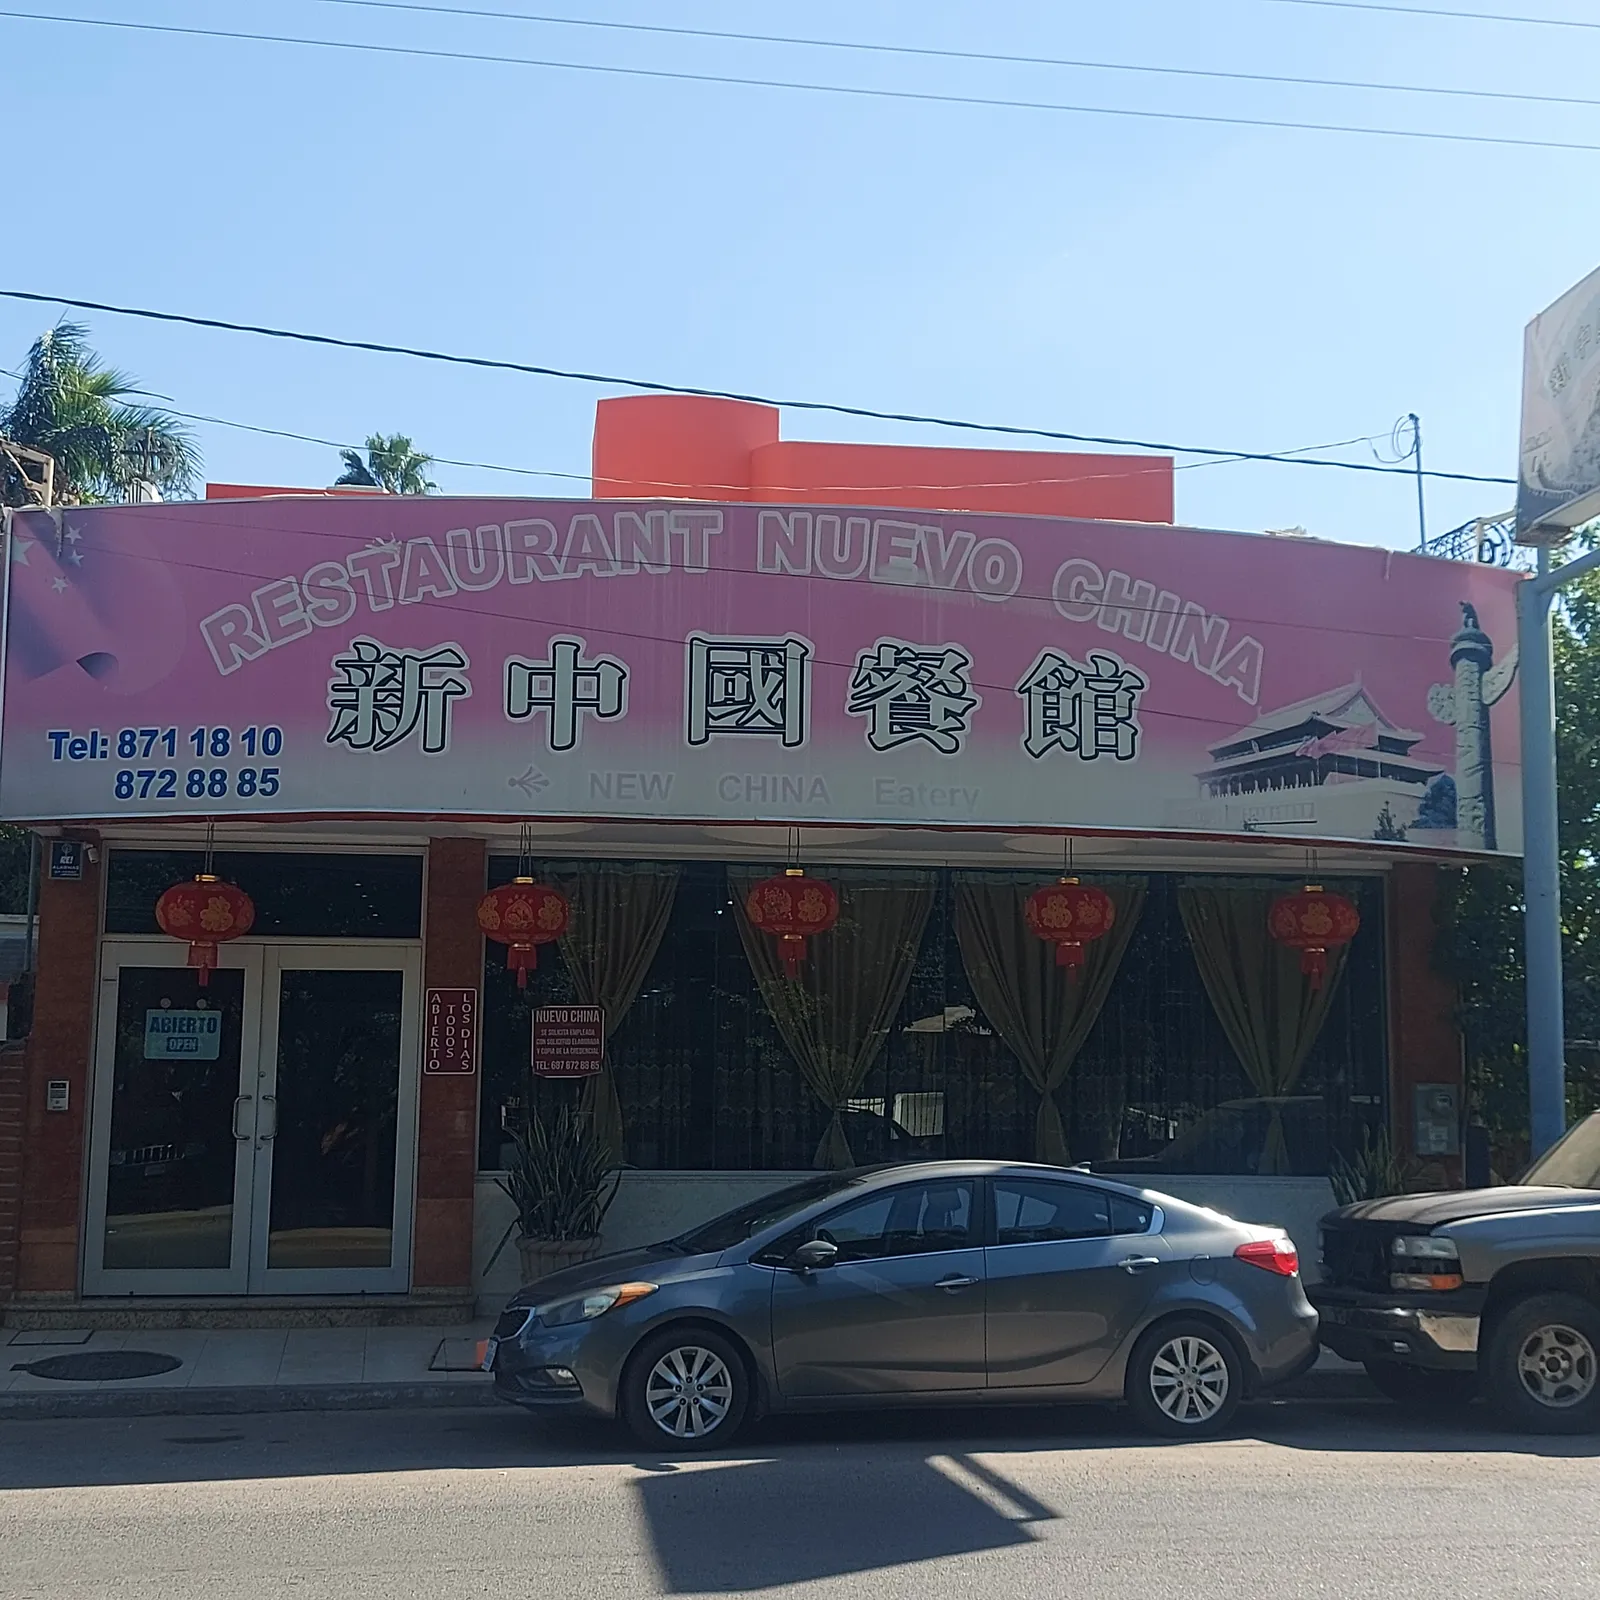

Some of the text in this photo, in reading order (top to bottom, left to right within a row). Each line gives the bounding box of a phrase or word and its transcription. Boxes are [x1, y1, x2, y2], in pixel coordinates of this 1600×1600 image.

[200, 510, 1265, 705] RESTAURANT NUEVO CHINA
[327, 635, 1146, 761] 新中國餐館
[48, 727, 282, 760] Tel: 871 18 10
[115, 768, 279, 799] 872 88 85
[588, 772, 980, 812] NEW CHINA Eatery
[149, 1016, 218, 1034] ABIERTO
[428, 993, 442, 1070] ABIERTO
[445, 1004, 456, 1059] TODOS
[460, 993, 472, 1070] LOS DIAS
[536, 1010, 600, 1023] NUEVO CHINA
[168, 1038, 197, 1051] OPEN
